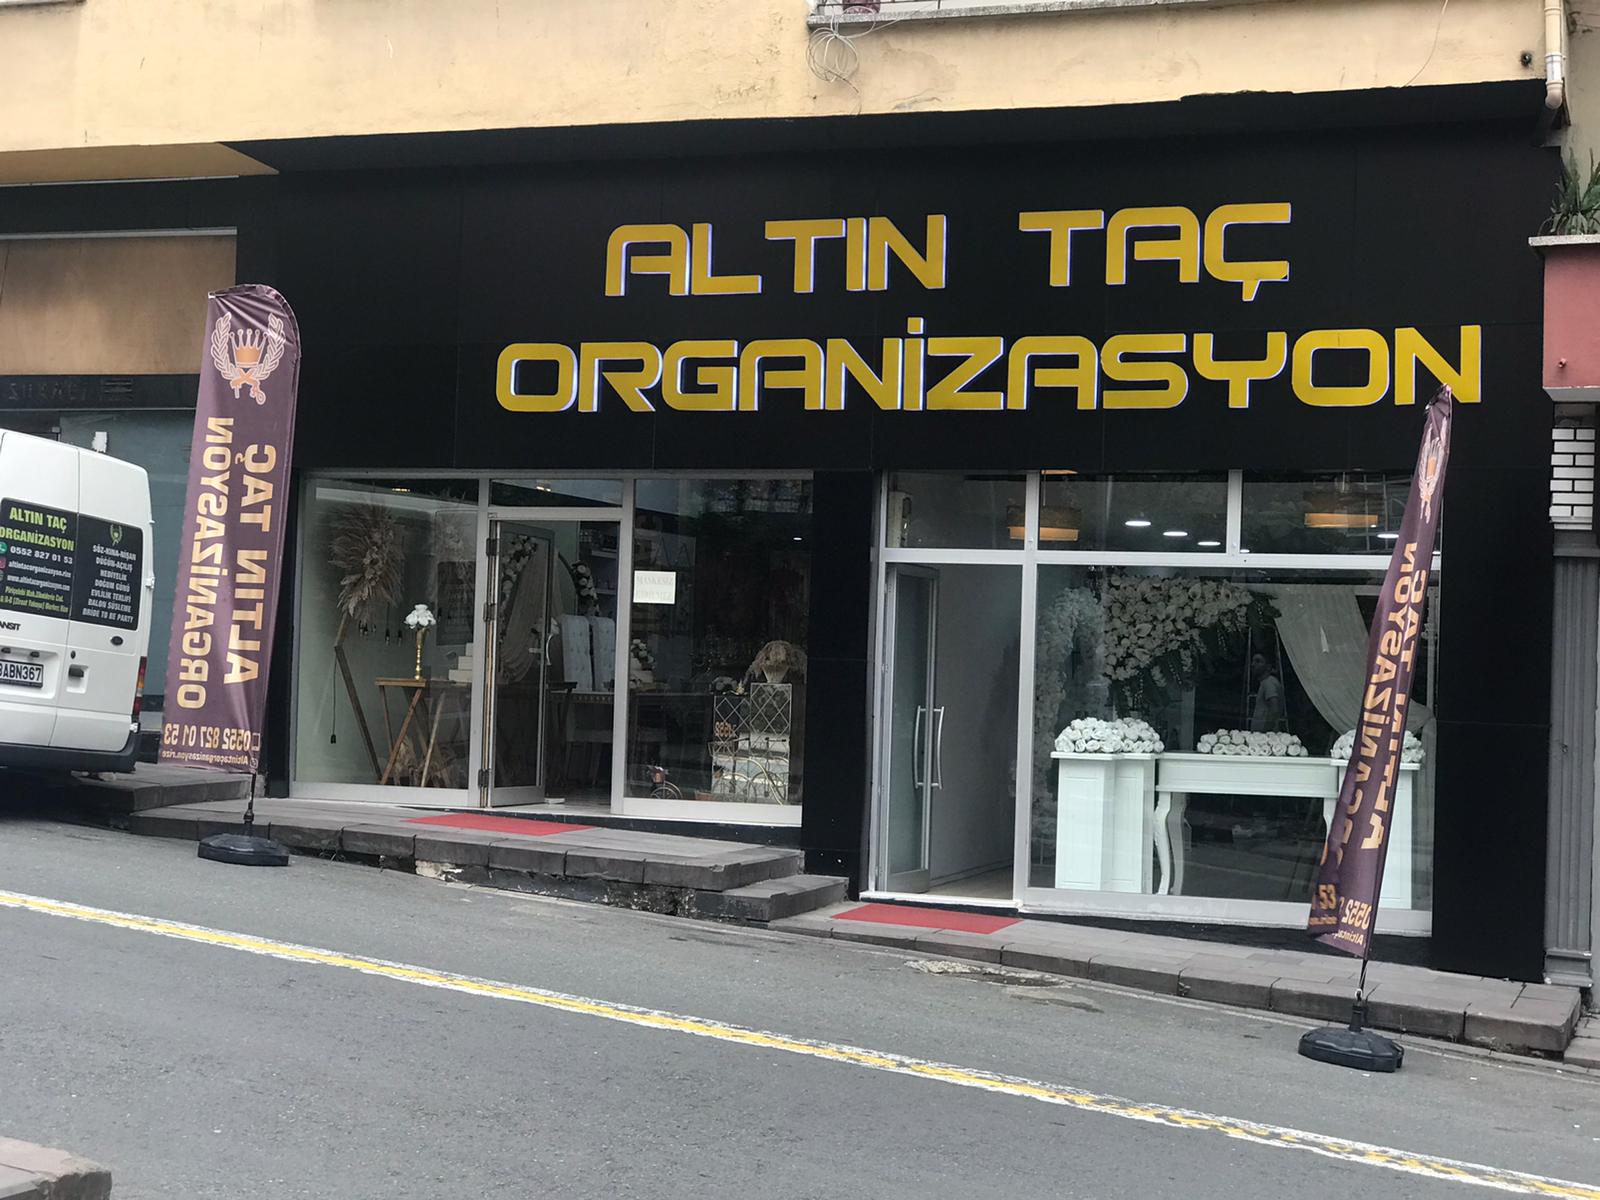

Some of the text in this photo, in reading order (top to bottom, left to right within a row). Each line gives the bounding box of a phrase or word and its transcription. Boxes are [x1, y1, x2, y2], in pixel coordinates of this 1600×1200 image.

[605, 202, 1292, 302] ALTIN TAÇ
[495, 317, 1482, 414] ORGANİZASYON
[9, 506, 67, 534] ALTIN TAÇ
[10, 546, 73, 565] 0552 827 01 53
